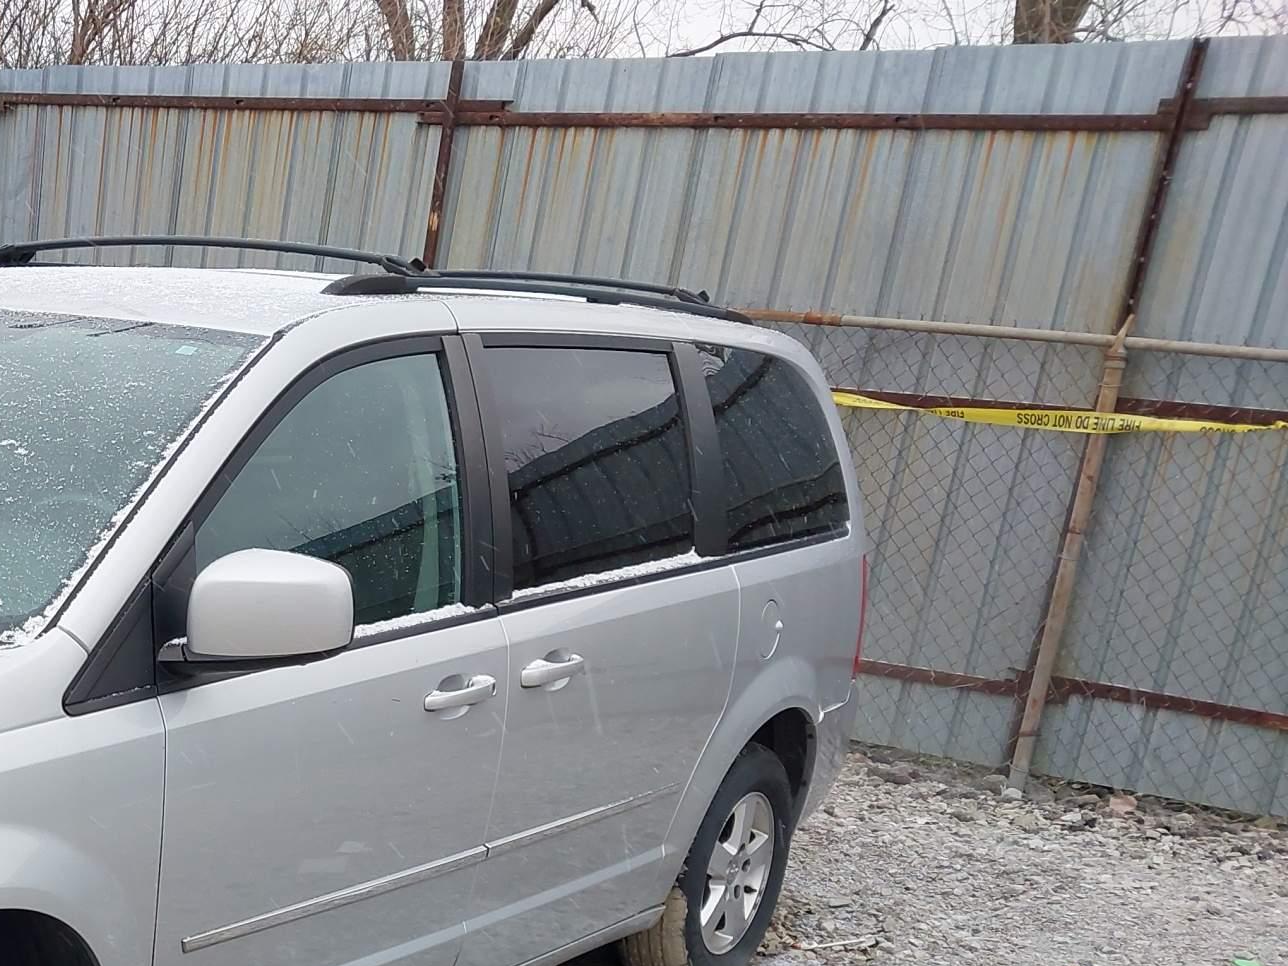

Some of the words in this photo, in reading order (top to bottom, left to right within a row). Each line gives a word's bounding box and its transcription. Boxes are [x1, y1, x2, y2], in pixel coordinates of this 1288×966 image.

[1016, 412, 1050, 426] CROSS
[1053, 414, 1073, 429] NOT
[1075, 415, 1090, 430] DO
[1093, 416, 1116, 431] LINE
[1118, 418, 1142, 431] FIRE
